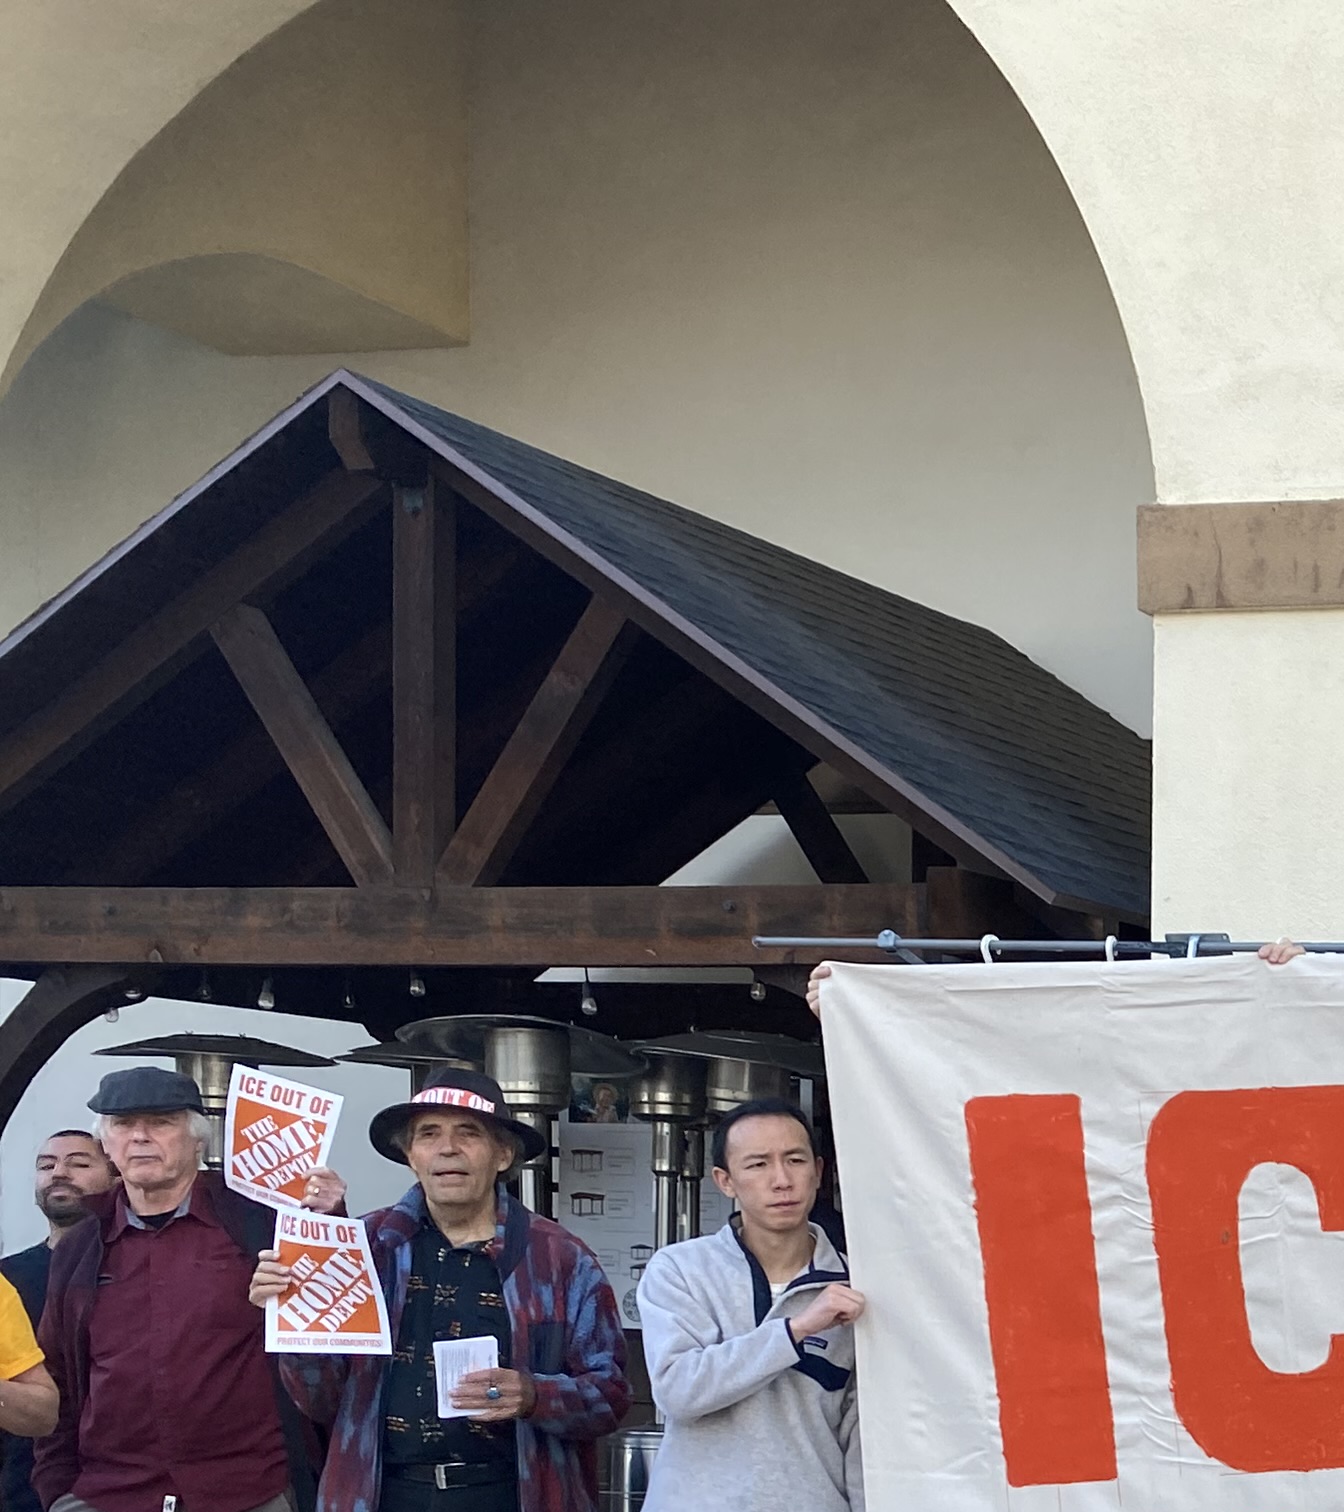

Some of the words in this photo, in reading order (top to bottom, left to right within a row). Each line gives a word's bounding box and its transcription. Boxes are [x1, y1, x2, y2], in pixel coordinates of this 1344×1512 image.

[238, 1073, 267, 1098] ICE
[270, 1084, 307, 1110] OUT
[309, 1096, 334, 1117] OF
[232, 1117, 325, 1181] HOME
[240, 1115, 280, 1143] THE
[261, 1151, 315, 1191] DEPOT
[280, 1213, 297, 1236] ICE
[300, 1219, 330, 1242] OUT
[335, 1225, 357, 1244] OF
[278, 1248, 366, 1332] HOME
[318, 1278, 374, 1333] DEPOT
